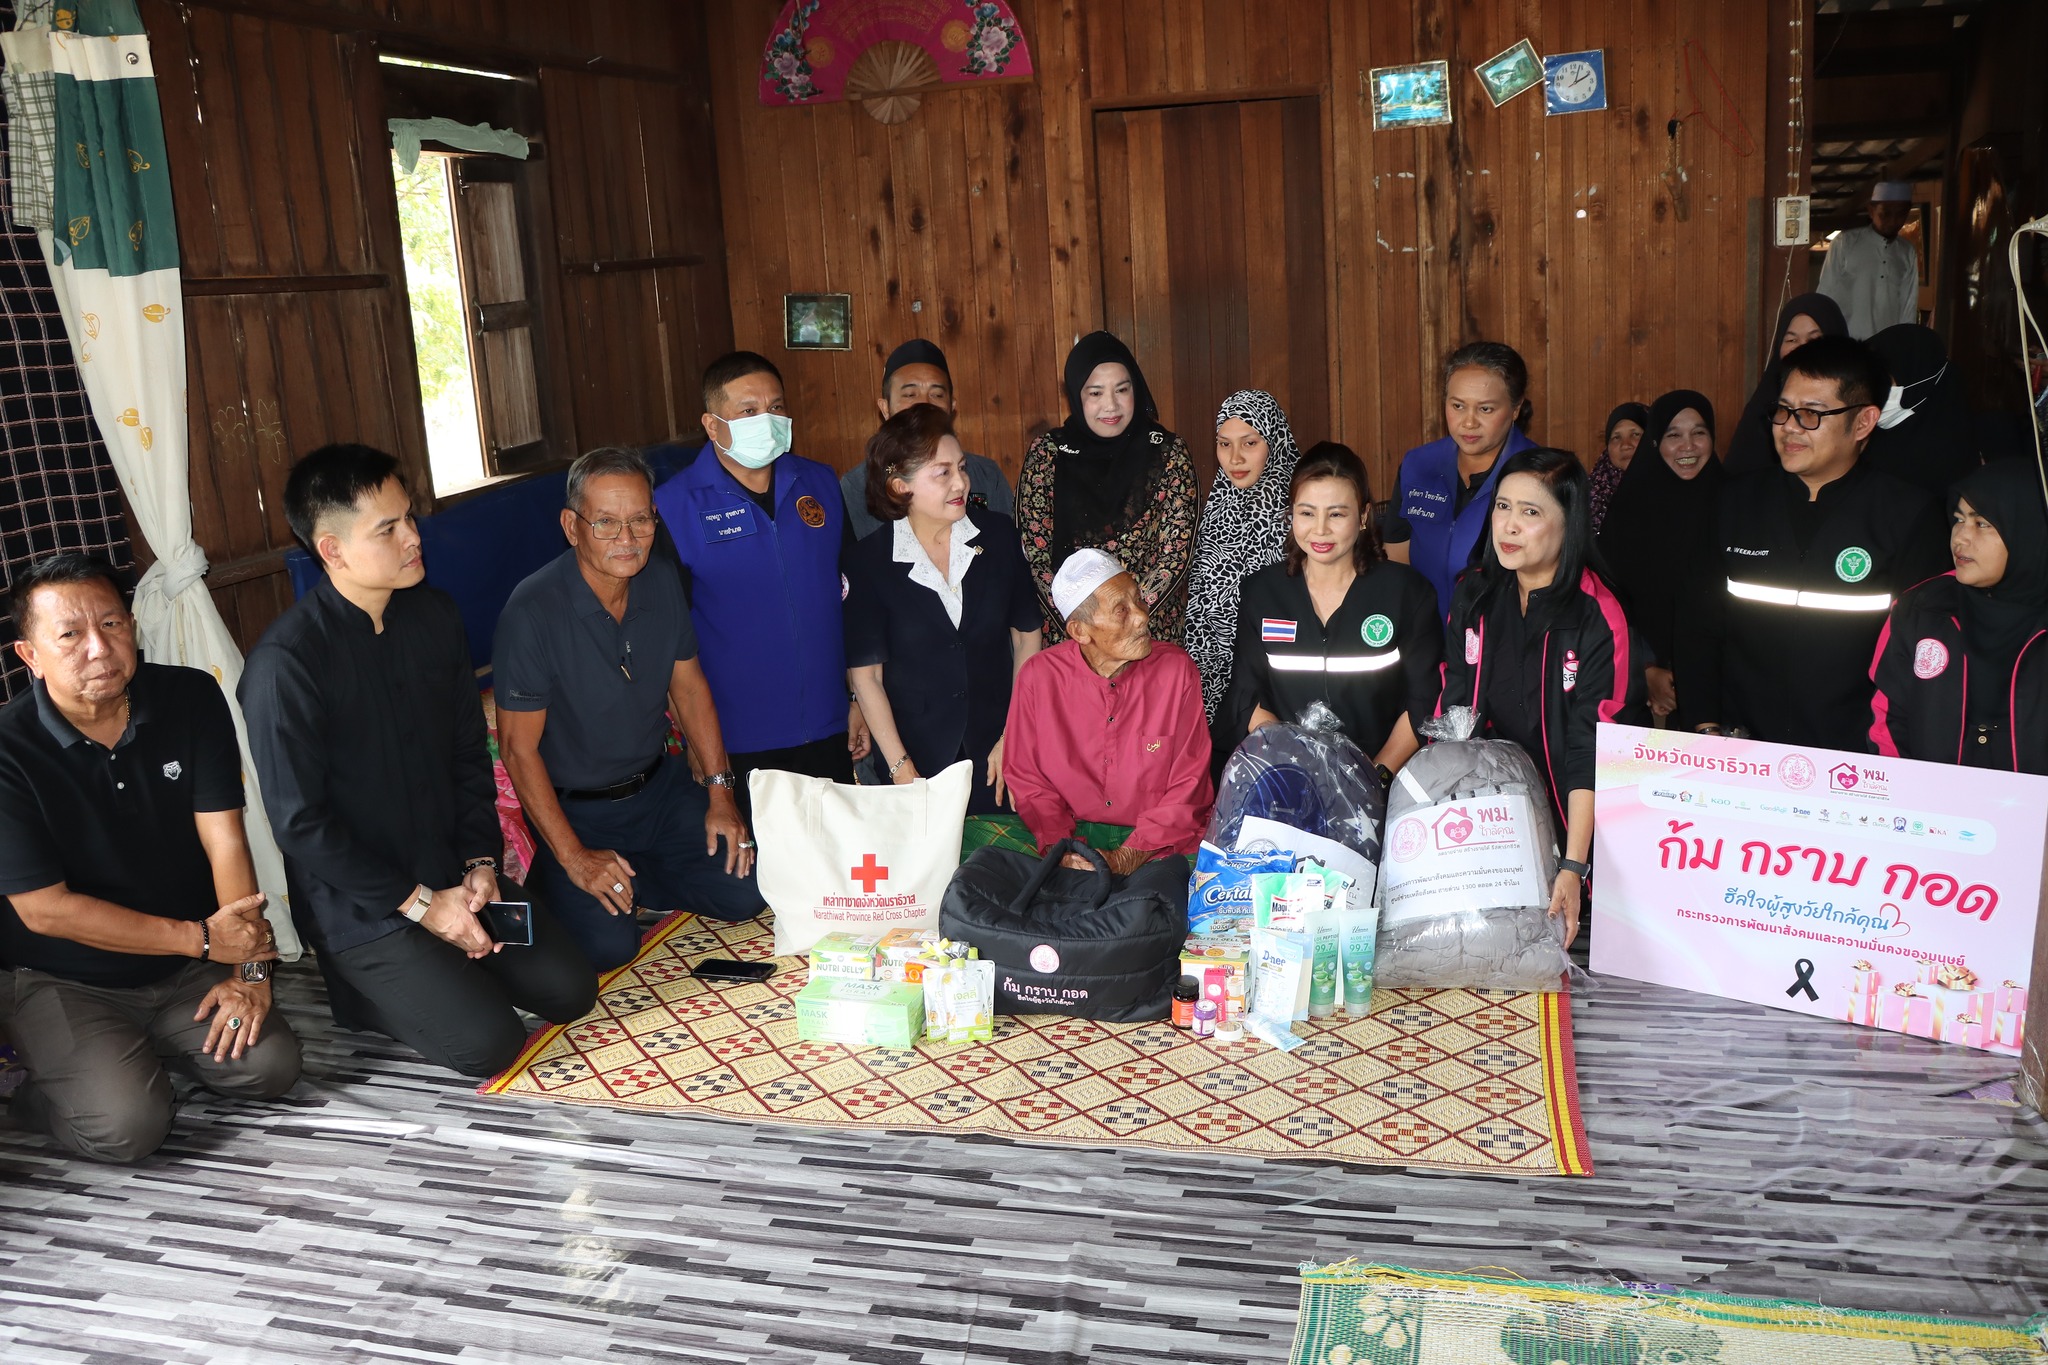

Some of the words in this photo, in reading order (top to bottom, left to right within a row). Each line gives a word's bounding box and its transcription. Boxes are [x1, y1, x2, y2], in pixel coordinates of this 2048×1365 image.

[1633, 743, 1771, 777] จังหวัดนราธิวาส
[1863, 768, 1889, 782] พม.
[1477, 806, 1514, 823] พม.
[1658, 820, 1724, 870] ก้ม
[1741, 841, 1868, 886] กราบ
[1883, 863, 1999, 921] กอด
[1204, 885, 1253, 904] Certai
[1461, 883, 1476, 891] 1300
[823, 892, 916, 908] เหล่ากาชาดจังหวัดนราธิวาส
[813, 909, 845, 921] Narathiwat
[846, 911, 871, 922] Province
[872, 911, 884, 921] Red
[885, 910, 902, 921] Cross
[903, 907, 927, 919] Chapter
[1724, 888, 1889, 934] ฮีลใจผู้สูงวัยใกล้คุณ
[1677, 907, 1966, 967] กระทรวงการพัฒนาสังคมและความมั่นคงของมนุษย์
[882, 958, 904, 968] NUTR
[1262, 949, 1286, 967] D-nee
[816, 963, 840, 973] NUTRI
[842, 965, 865, 974] JELLY
[844, 982, 883, 991] MASK
[954, 986, 977, 1001] เจลลี่
[1003, 976, 1020, 993] ก้ม
[1025, 985, 1057, 997] กราบ
[1062, 989, 1088, 999] กอด
[801, 1008, 828, 1019] MASK
